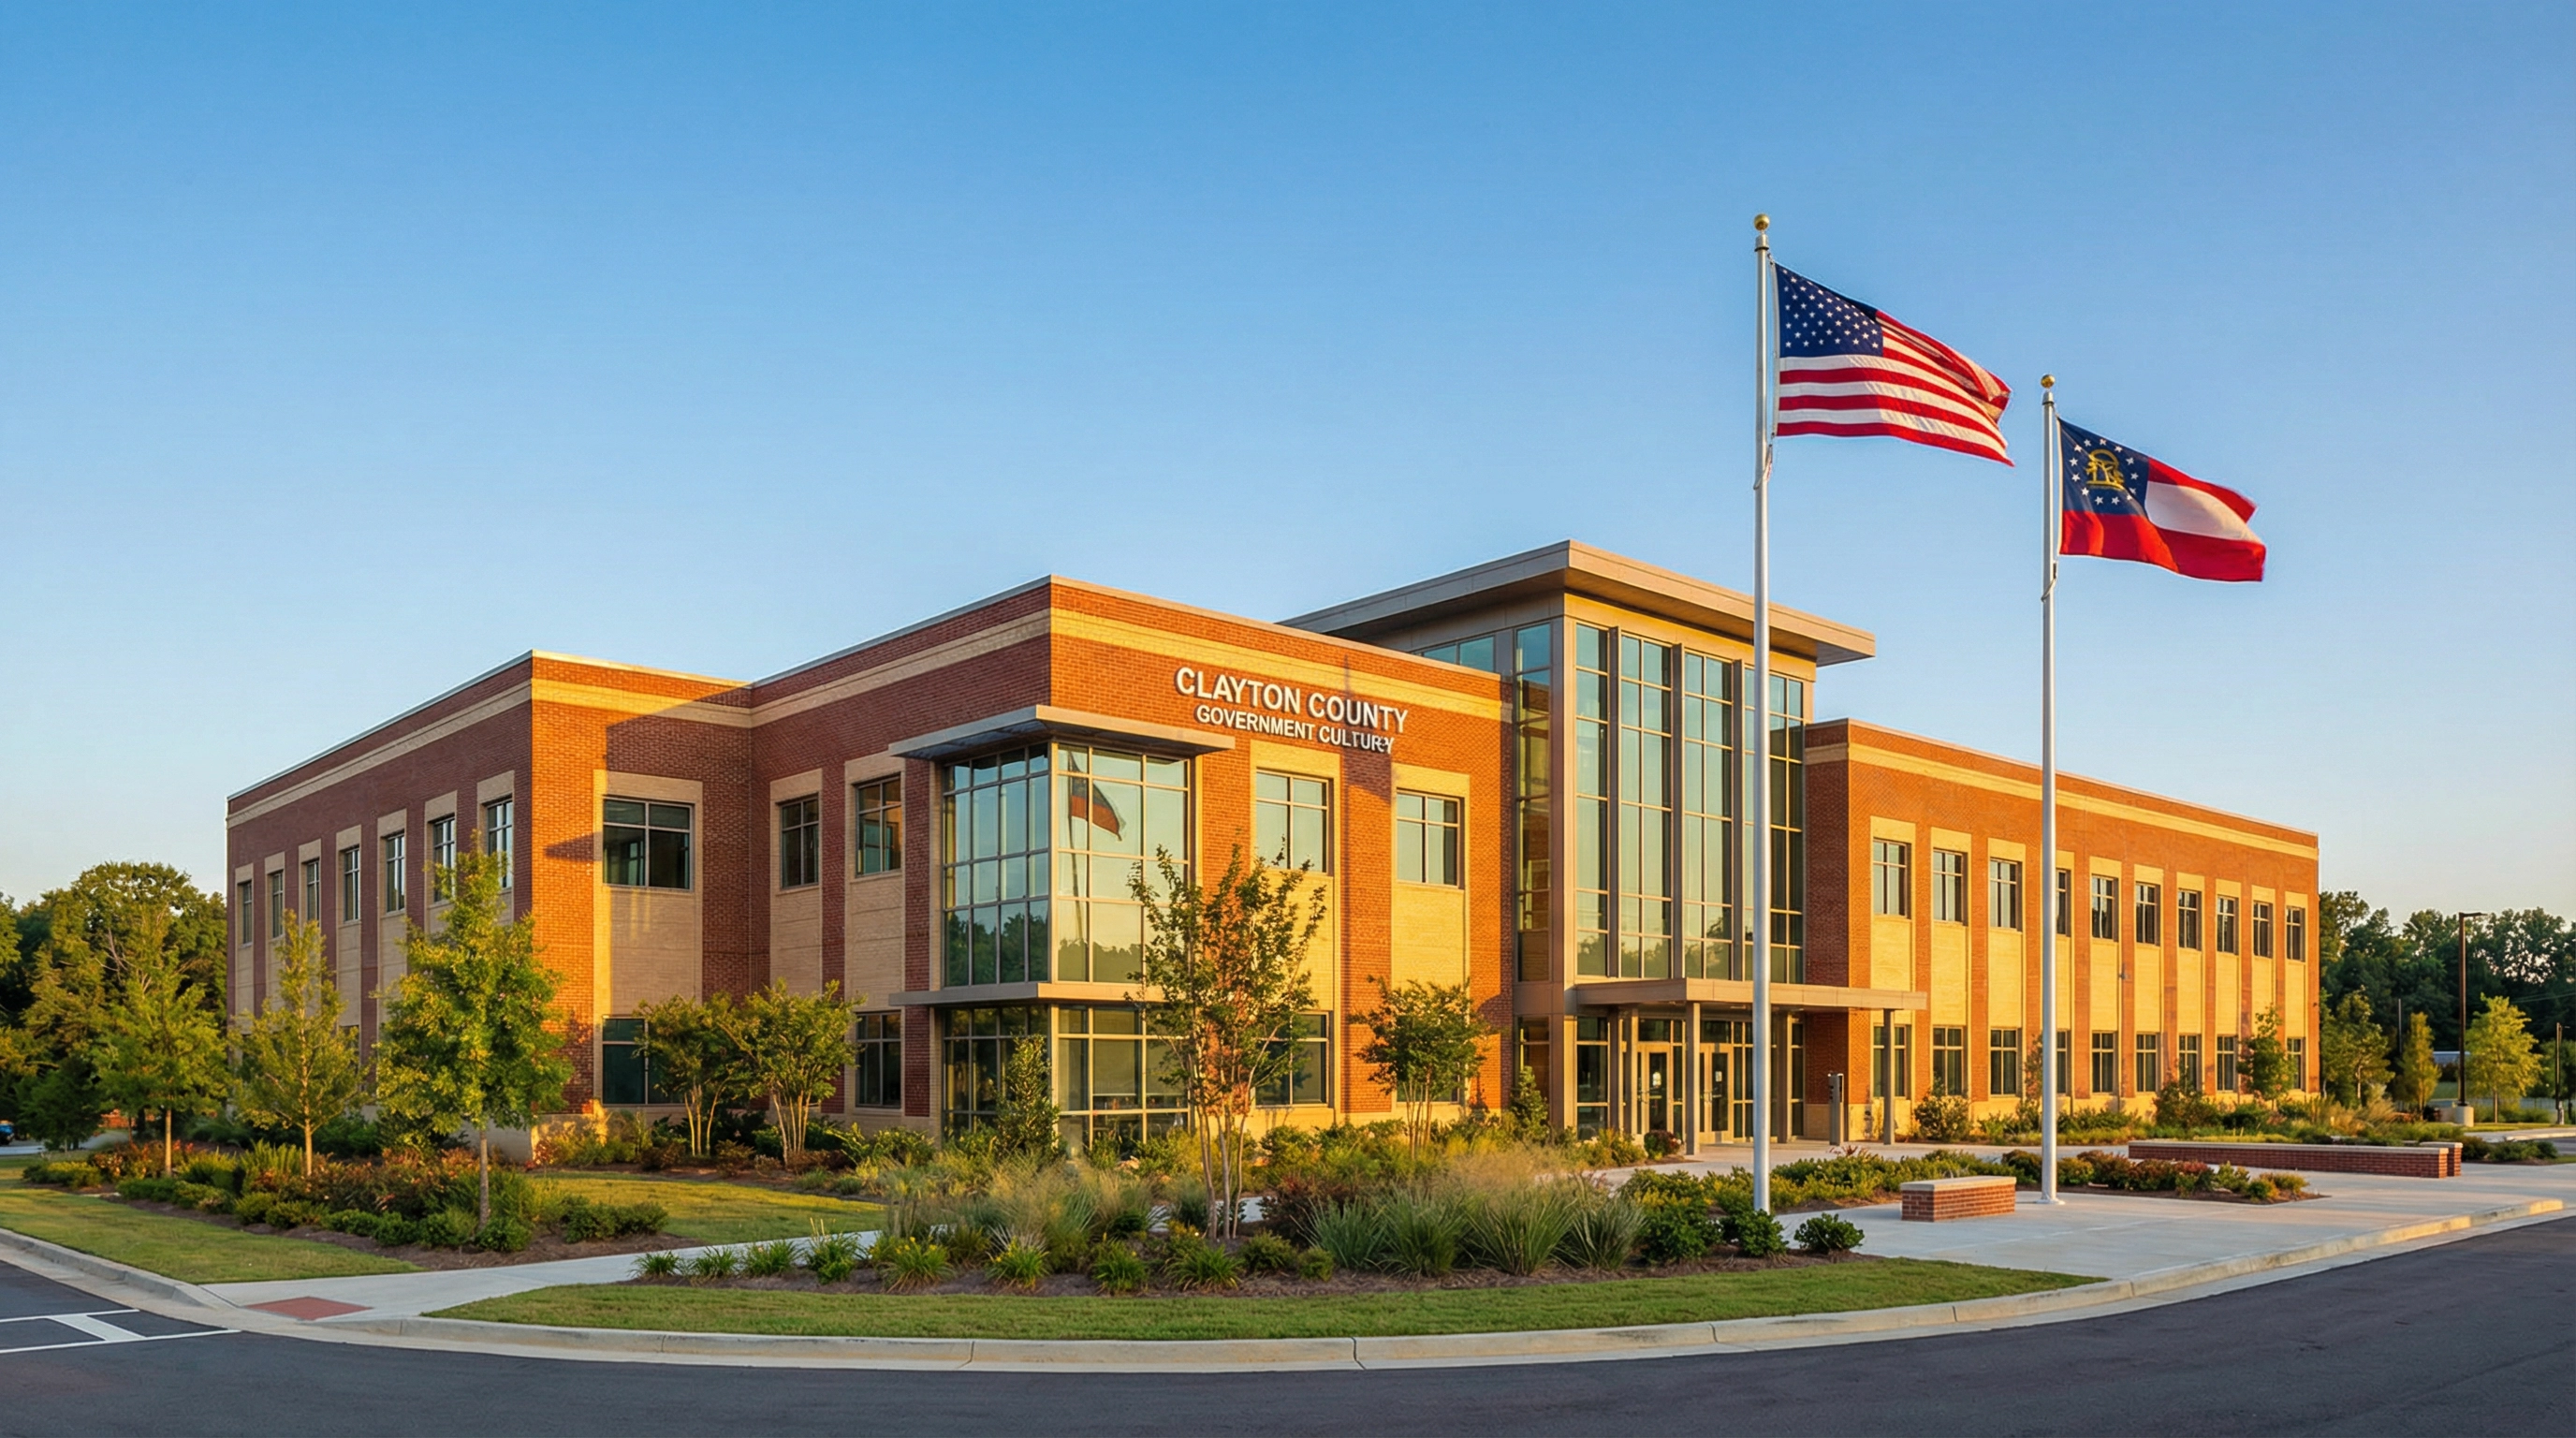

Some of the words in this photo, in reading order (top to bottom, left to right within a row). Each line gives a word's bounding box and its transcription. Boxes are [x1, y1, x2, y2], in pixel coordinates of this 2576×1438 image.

[1177, 667, 1301, 714] CLAYTON
[1309, 692, 1408, 733] COUNTY
[1196, 704, 1315, 741] GOVERNMENT
